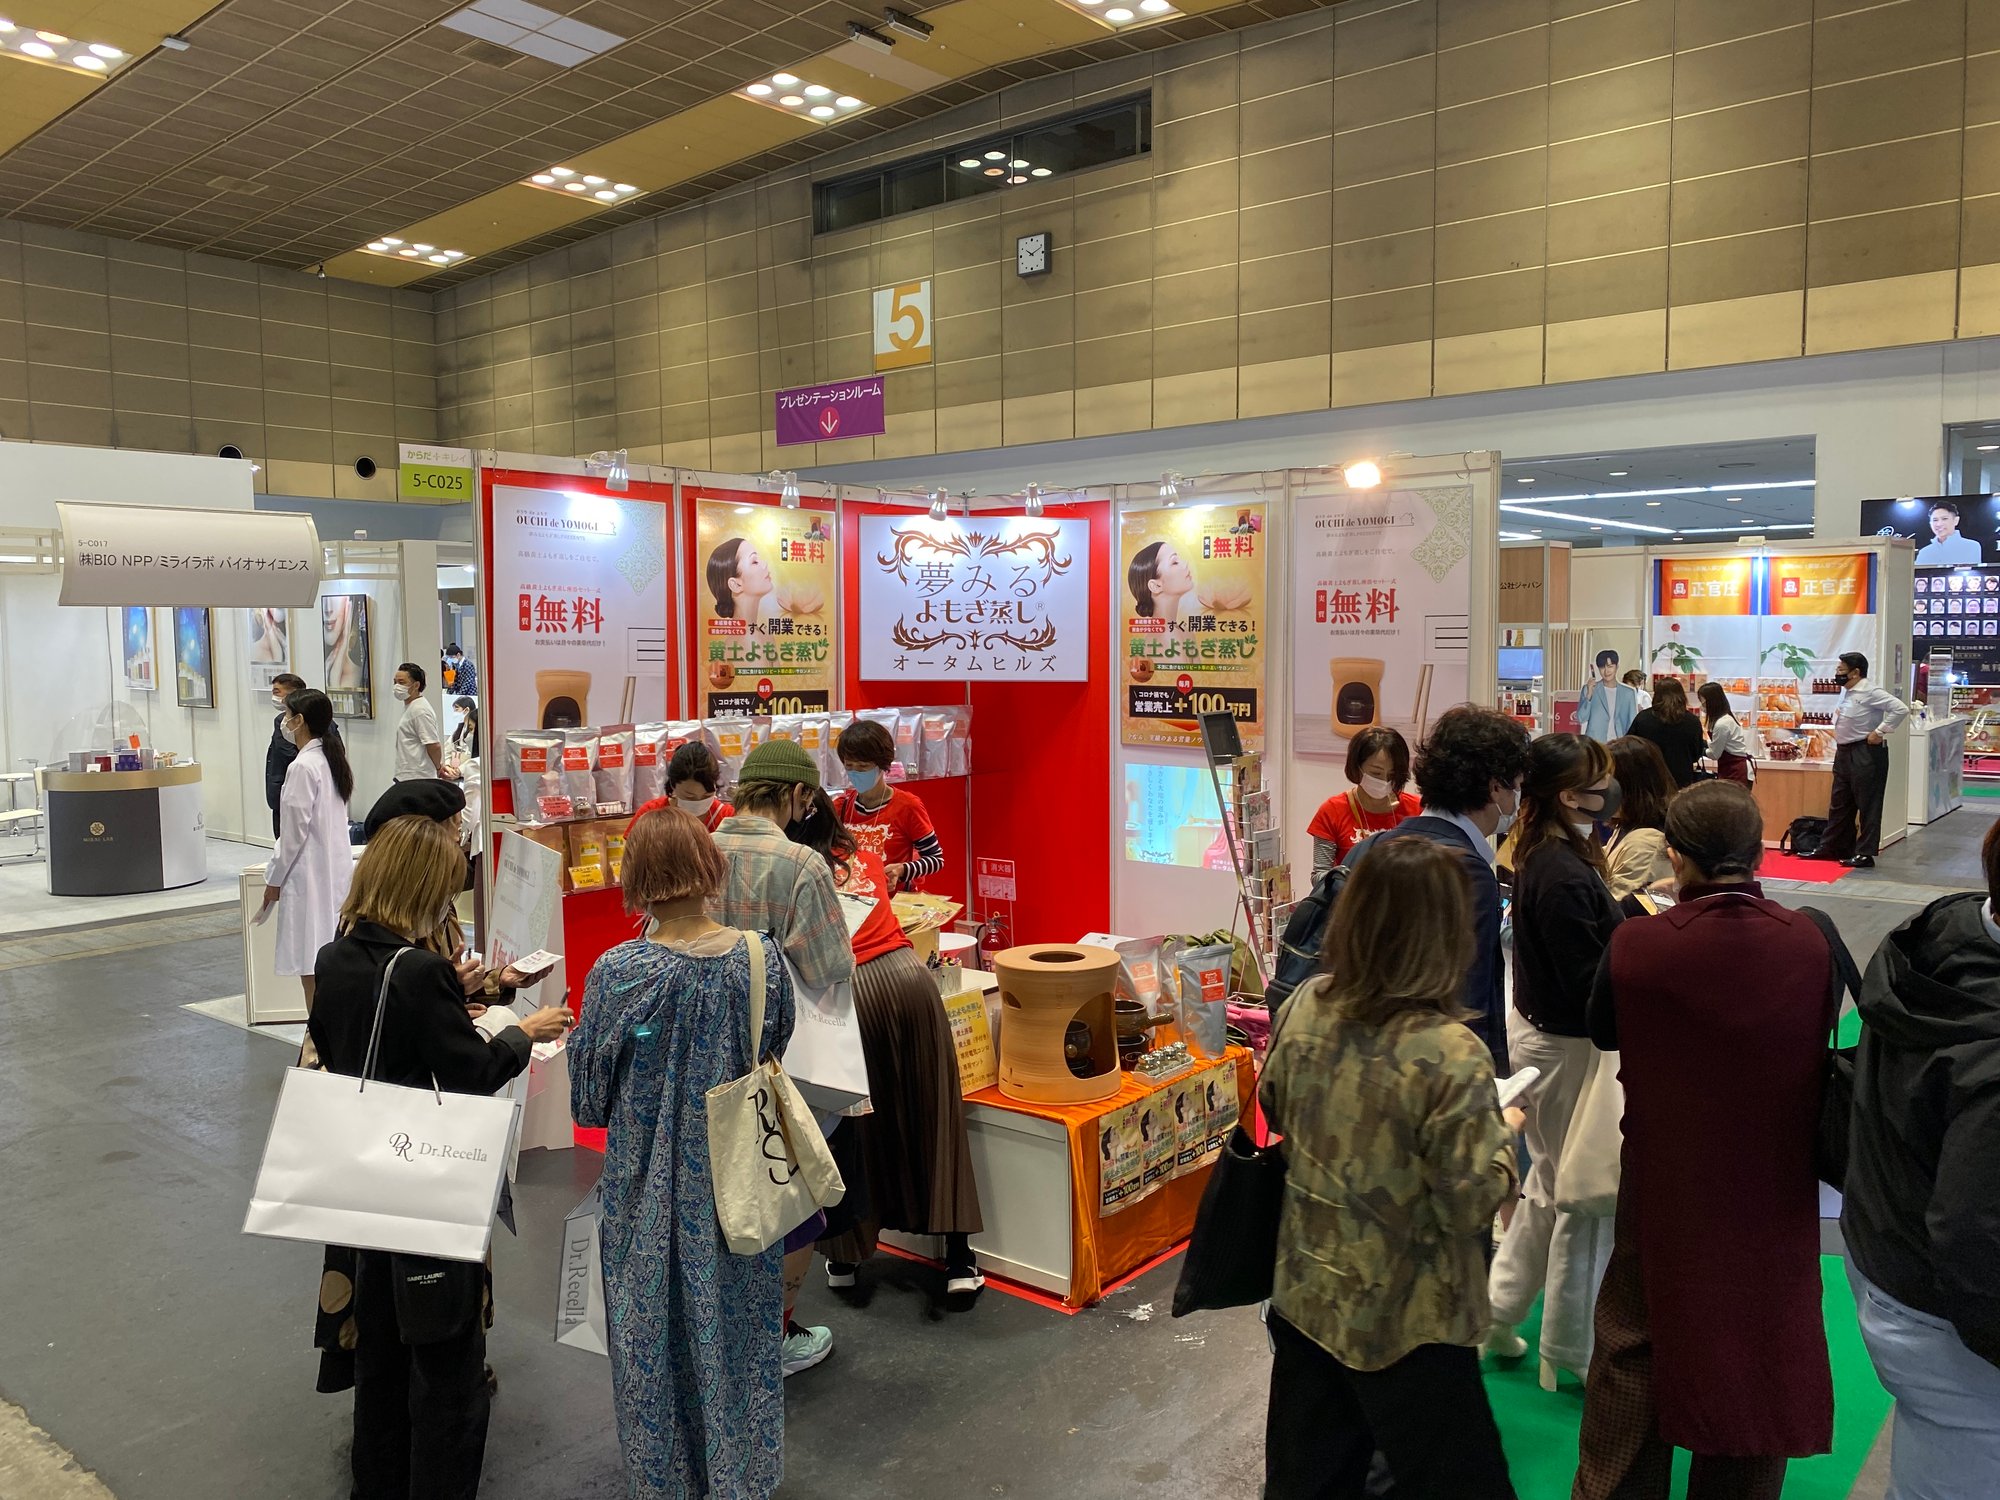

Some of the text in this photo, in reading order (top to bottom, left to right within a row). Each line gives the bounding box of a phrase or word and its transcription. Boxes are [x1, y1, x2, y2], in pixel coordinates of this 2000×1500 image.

[888, 281, 925, 351] 5
[780, 382, 882, 409] プレゼンテーションルーム
[413, 473, 463, 490] 5-C025
[516, 515, 548, 527] OUCHI
[560, 520, 598, 531] YOMOGI
[1315, 515, 1396, 529] OUCHI de YOMOGI
[78, 539, 108, 547] 5-C017
[790, 540, 826, 563] 無料
[1213, 535, 1254, 558] 無料
[122, 555, 215, 570] NPP/ミライラボ
[219, 556, 310, 571] バイオサイエンス
[915, 561, 1037, 598] 夢みる
[1691, 580, 1740, 597] 正官庄
[1802, 577, 1856, 596] 正官庄
[521, 599, 529, 626] 実質
[533, 594, 605, 634] 無料
[1318, 595, 1325, 618] 実質
[1329, 588, 1400, 624] 無料
[748, 618, 828, 635] すぐ開業できる！
[1167, 615, 1256, 632] すぐ開業できる！
[708, 640, 828, 662] 黄土よもぎ蒸し
[1129, 637, 1256, 659] 黄土よもぎ蒸し
[893, 655, 1057, 672] オータムヒルズ
[759, 685, 770, 693] 毎月
[1178, 680, 1190, 688] 毎月
[1134, 700, 1173, 713] 営業売上
[990, 863, 1013, 874] 消火器
[808, 1010, 847, 1027] Dr.Recella
[418, 1142, 488, 1162] Dr.Recella
[564, 1236, 590, 1325] Dr.Recella
